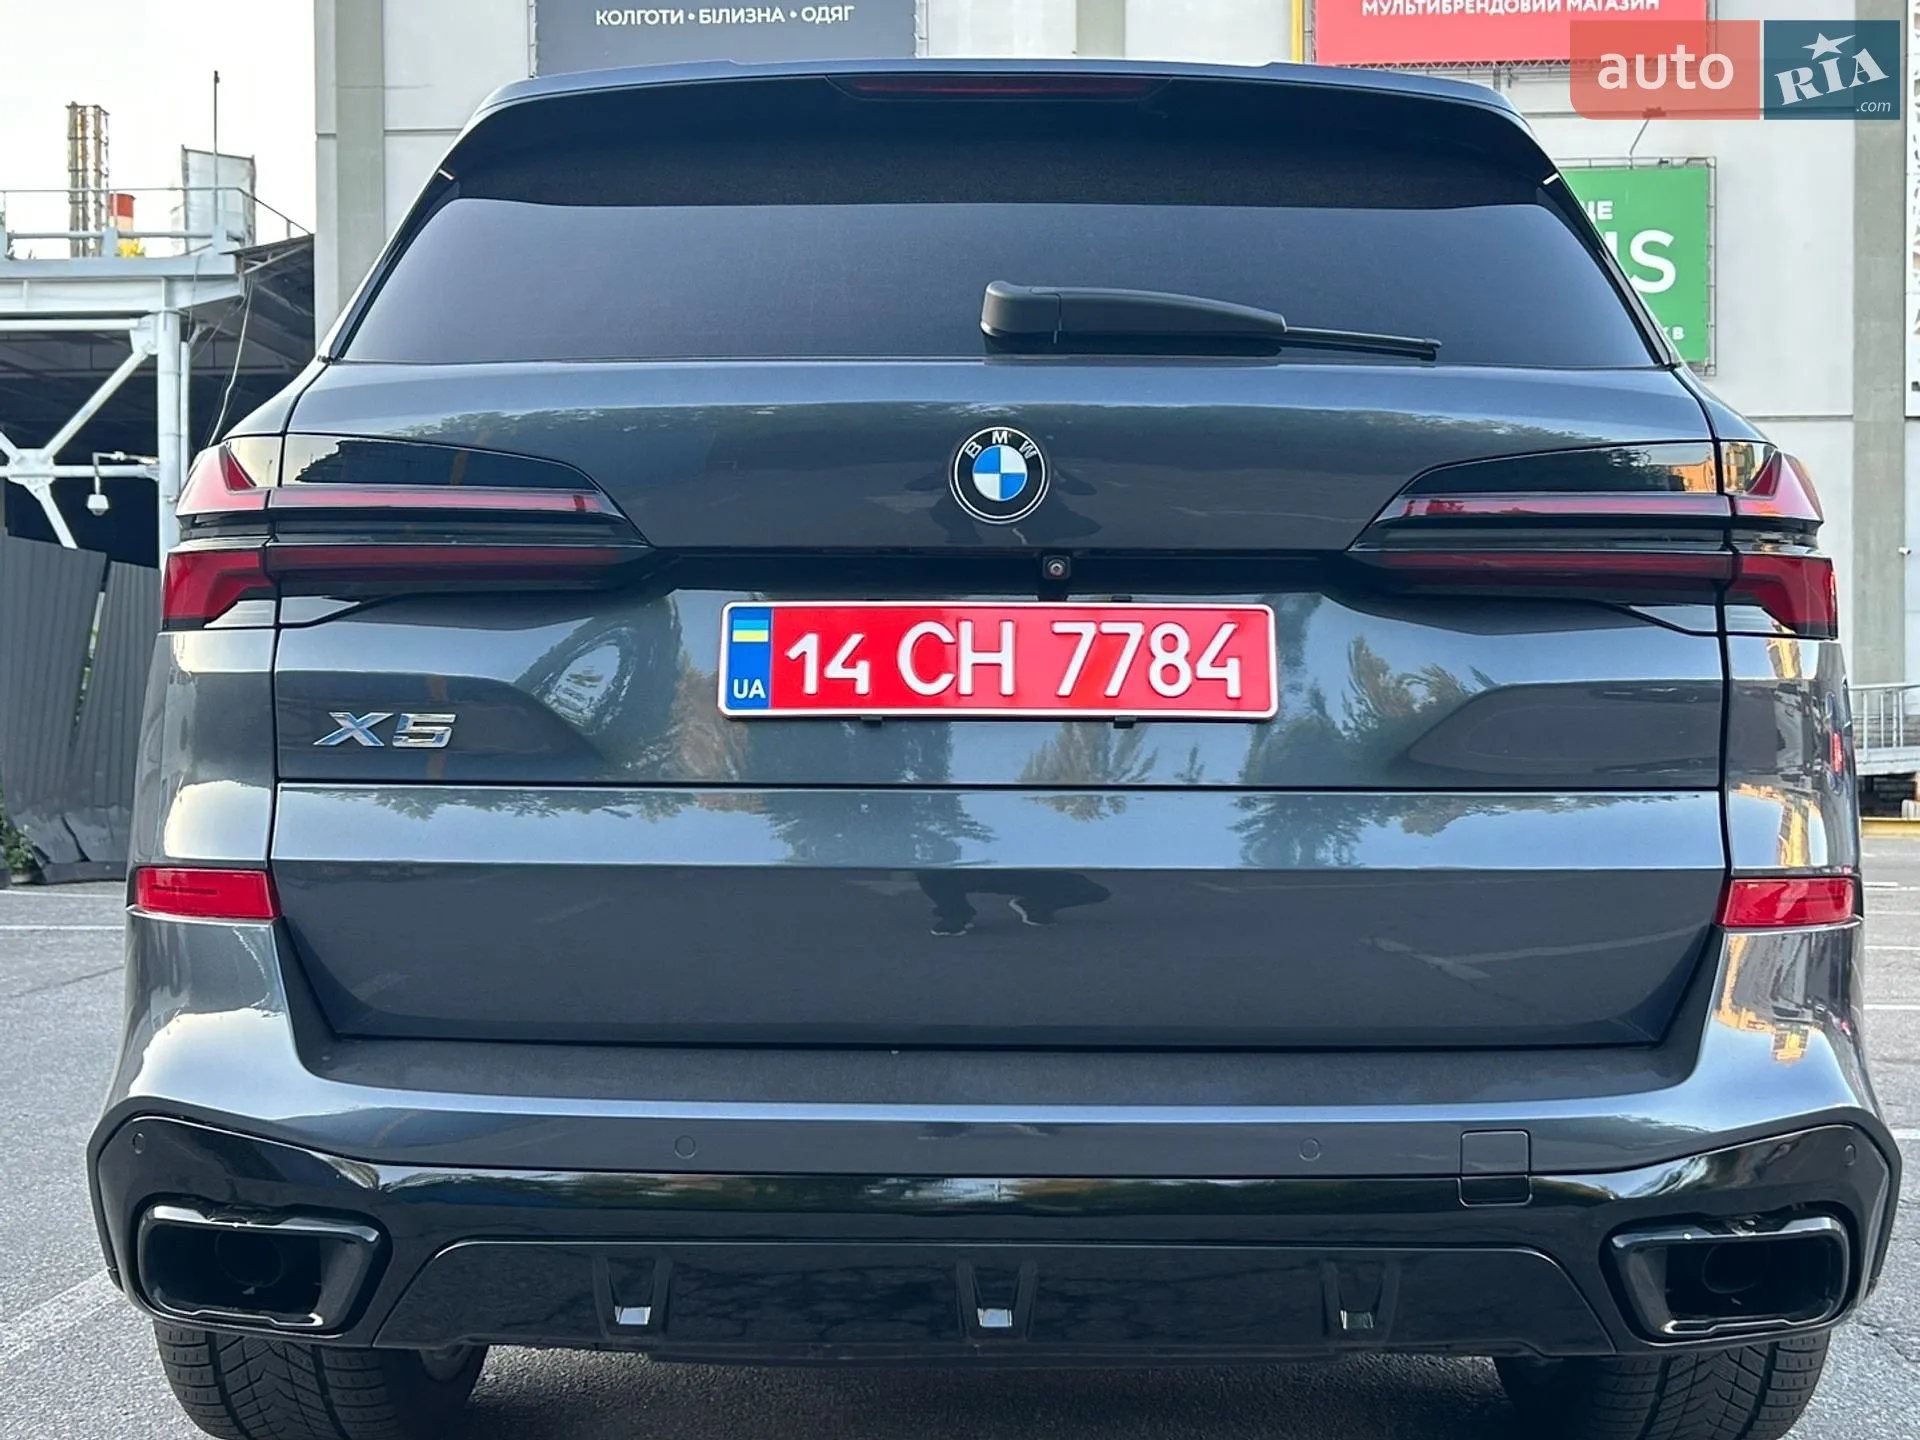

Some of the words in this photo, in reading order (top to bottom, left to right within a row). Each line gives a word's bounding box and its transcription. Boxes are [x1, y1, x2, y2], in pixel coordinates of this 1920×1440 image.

[596, 9, 684, 26] КОЛГОТИ
[699, 7, 785, 24] БІЛИЗНА
[801, 6, 855, 23] ОДЯГ
[964, 430, 1039, 459] BMW
[785, 632, 870, 696] 14
[896, 619, 1015, 696] CH
[1051, 621, 1243, 699] 7784
[733, 678, 766, 699] UA
[312, 711, 457, 748] X5
